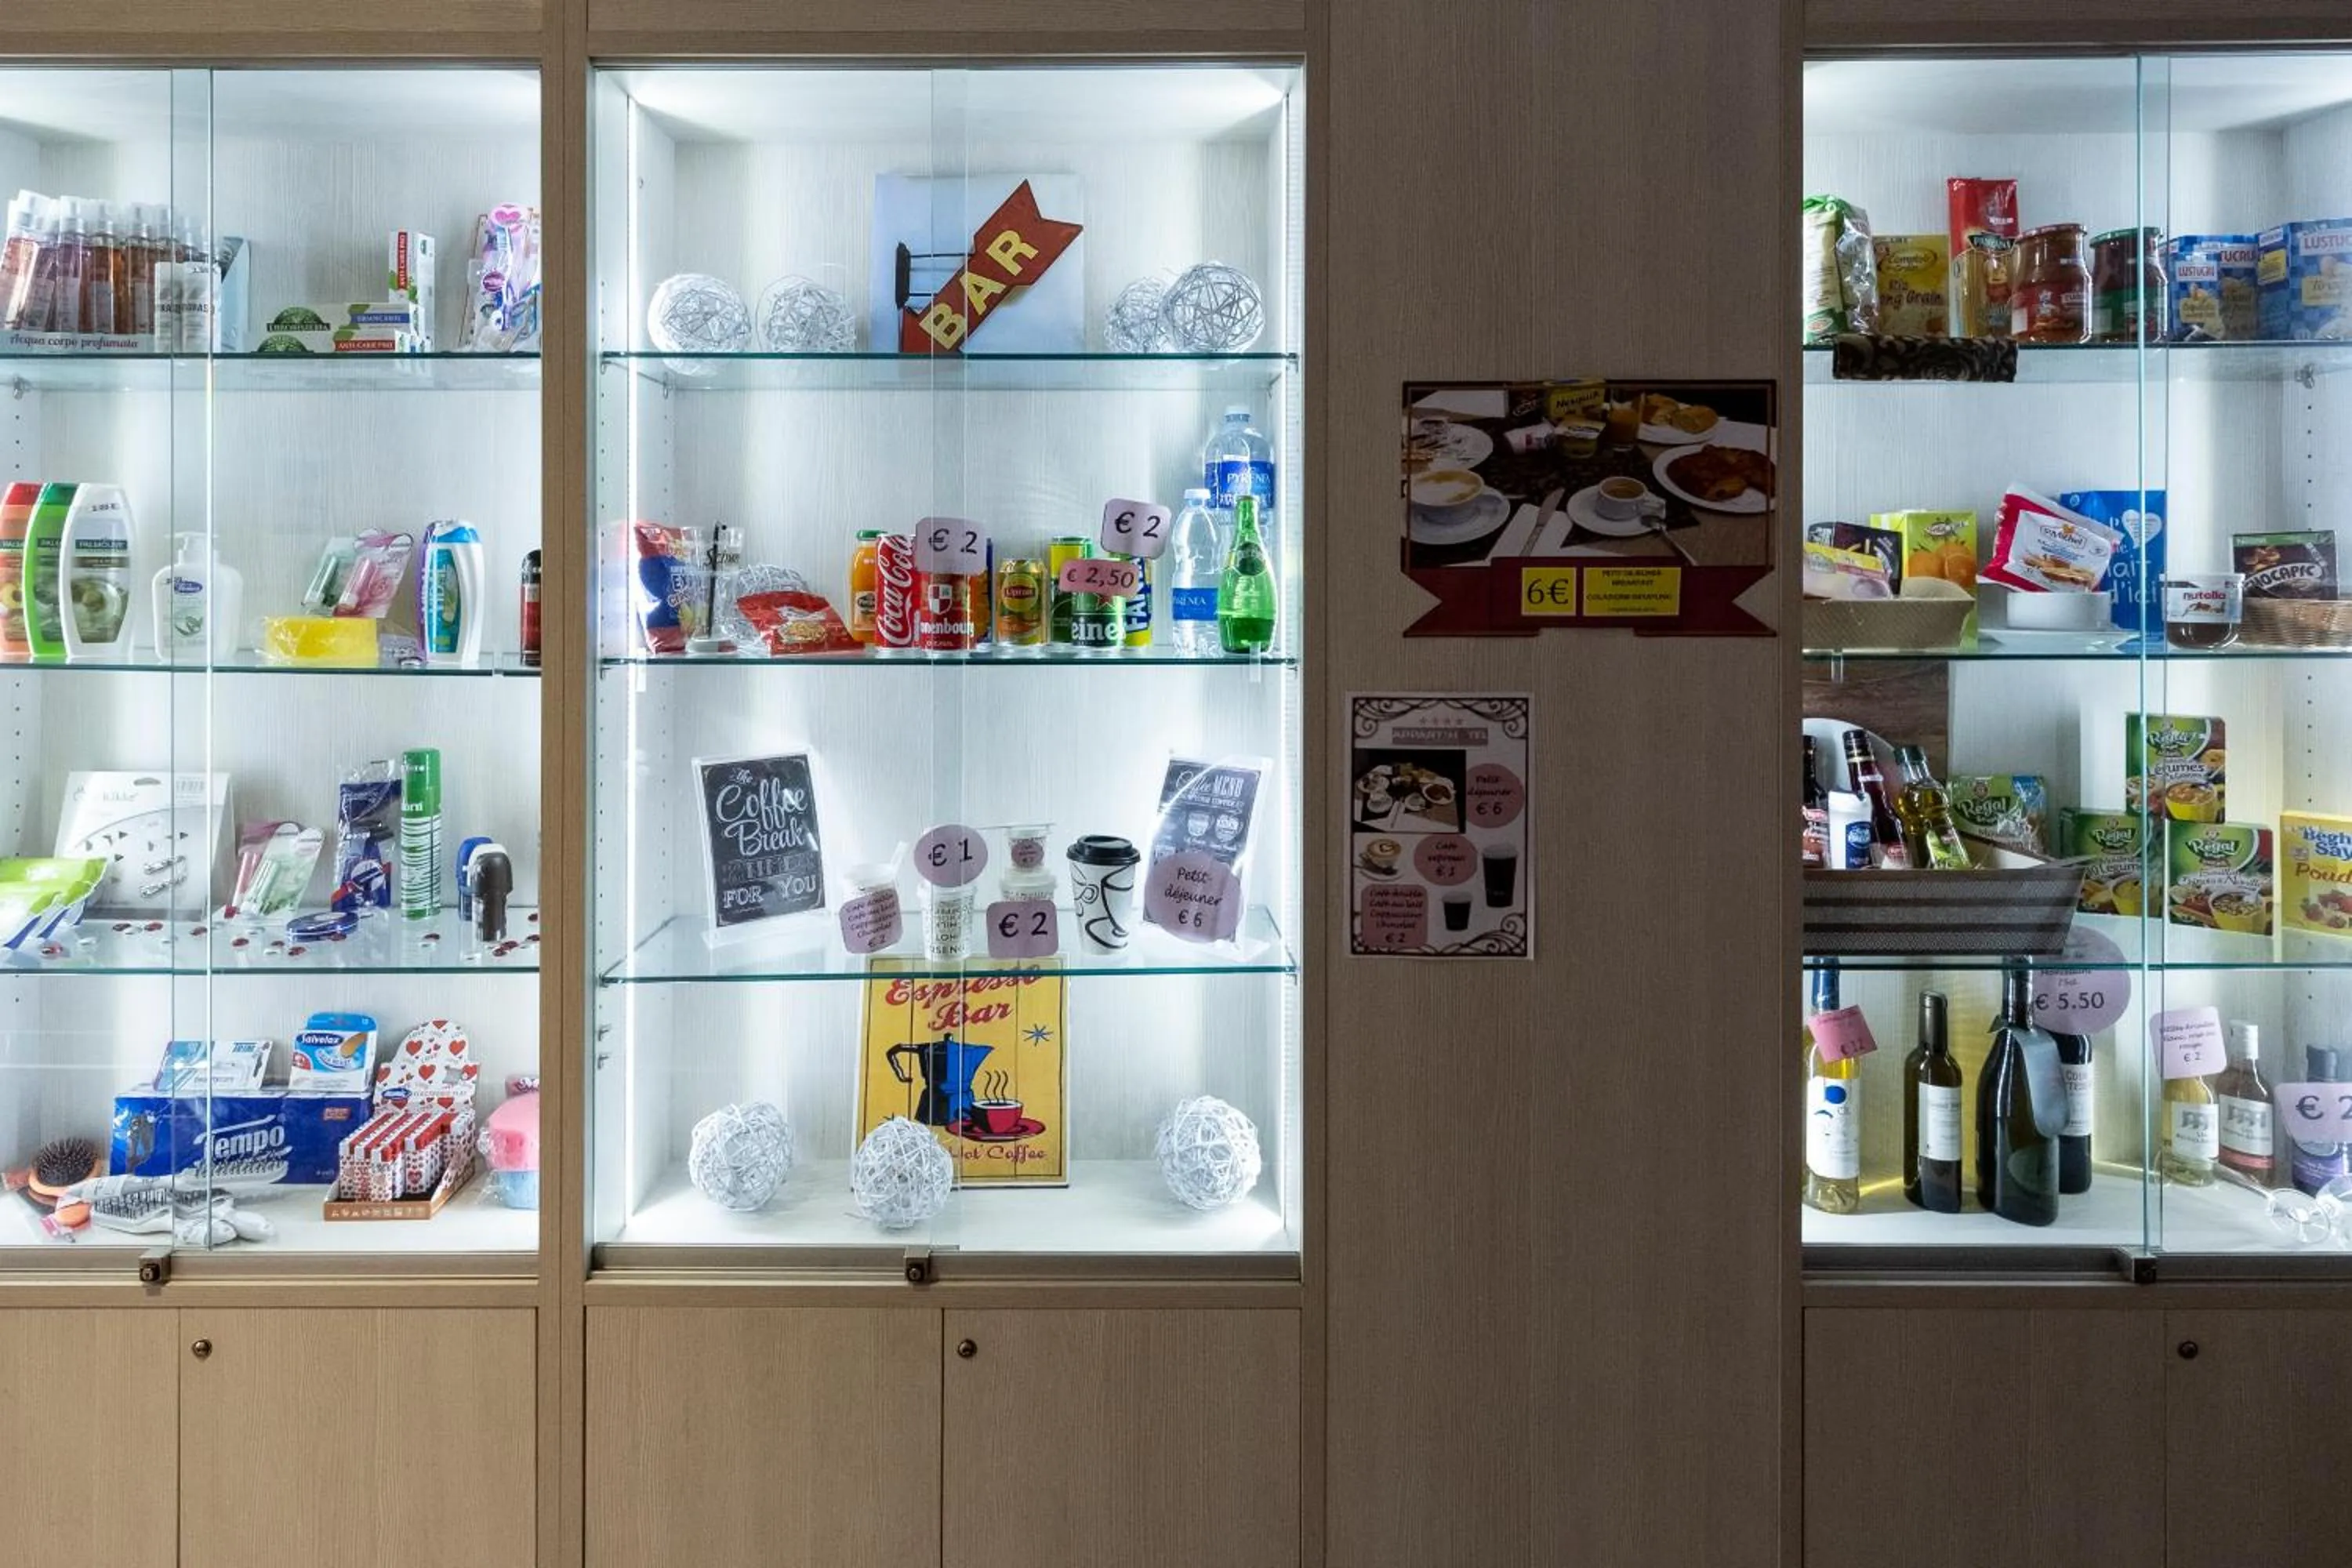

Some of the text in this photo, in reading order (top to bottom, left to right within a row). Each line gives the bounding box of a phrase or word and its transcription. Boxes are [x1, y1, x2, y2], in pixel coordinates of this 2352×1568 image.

[2303, 234, 2352, 250] LUSTUC
[919, 230, 1040, 350] BAR
[48, 336, 77, 348] corpo
[1114, 511, 1161, 538] € 2
[928, 528, 978, 554] € 2
[1066, 566, 1135, 588] € 2,50
[2183, 590, 2227, 600] nutella
[716, 776, 809, 831] Coffee
[1475, 802, 1503, 815] € 6
[1958, 797, 2007, 821] Regal
[724, 817, 805, 856] Break
[2189, 838, 2237, 856] Regal
[2303, 826, 2352, 846] Begh
[927, 837, 974, 867] € 1
[2315, 841, 2352, 861] Say
[2295, 861, 2352, 884] Poud
[722, 874, 817, 909] FOR YOU
[1164, 883, 1224, 907] déjeuner
[998, 911, 1048, 938] € 2
[1178, 909, 1203, 928] € 6
[885, 964, 1043, 1009] Espresso
[2034, 991, 2106, 1011] € 5.50
[927, 1000, 1014, 1032] Bar
[2183, 1052, 2191, 1063] €
[2296, 1095, 2352, 1121] € 2
[194, 1114, 286, 1159] Tempo
[987, 1144, 1047, 1164] Coffee
